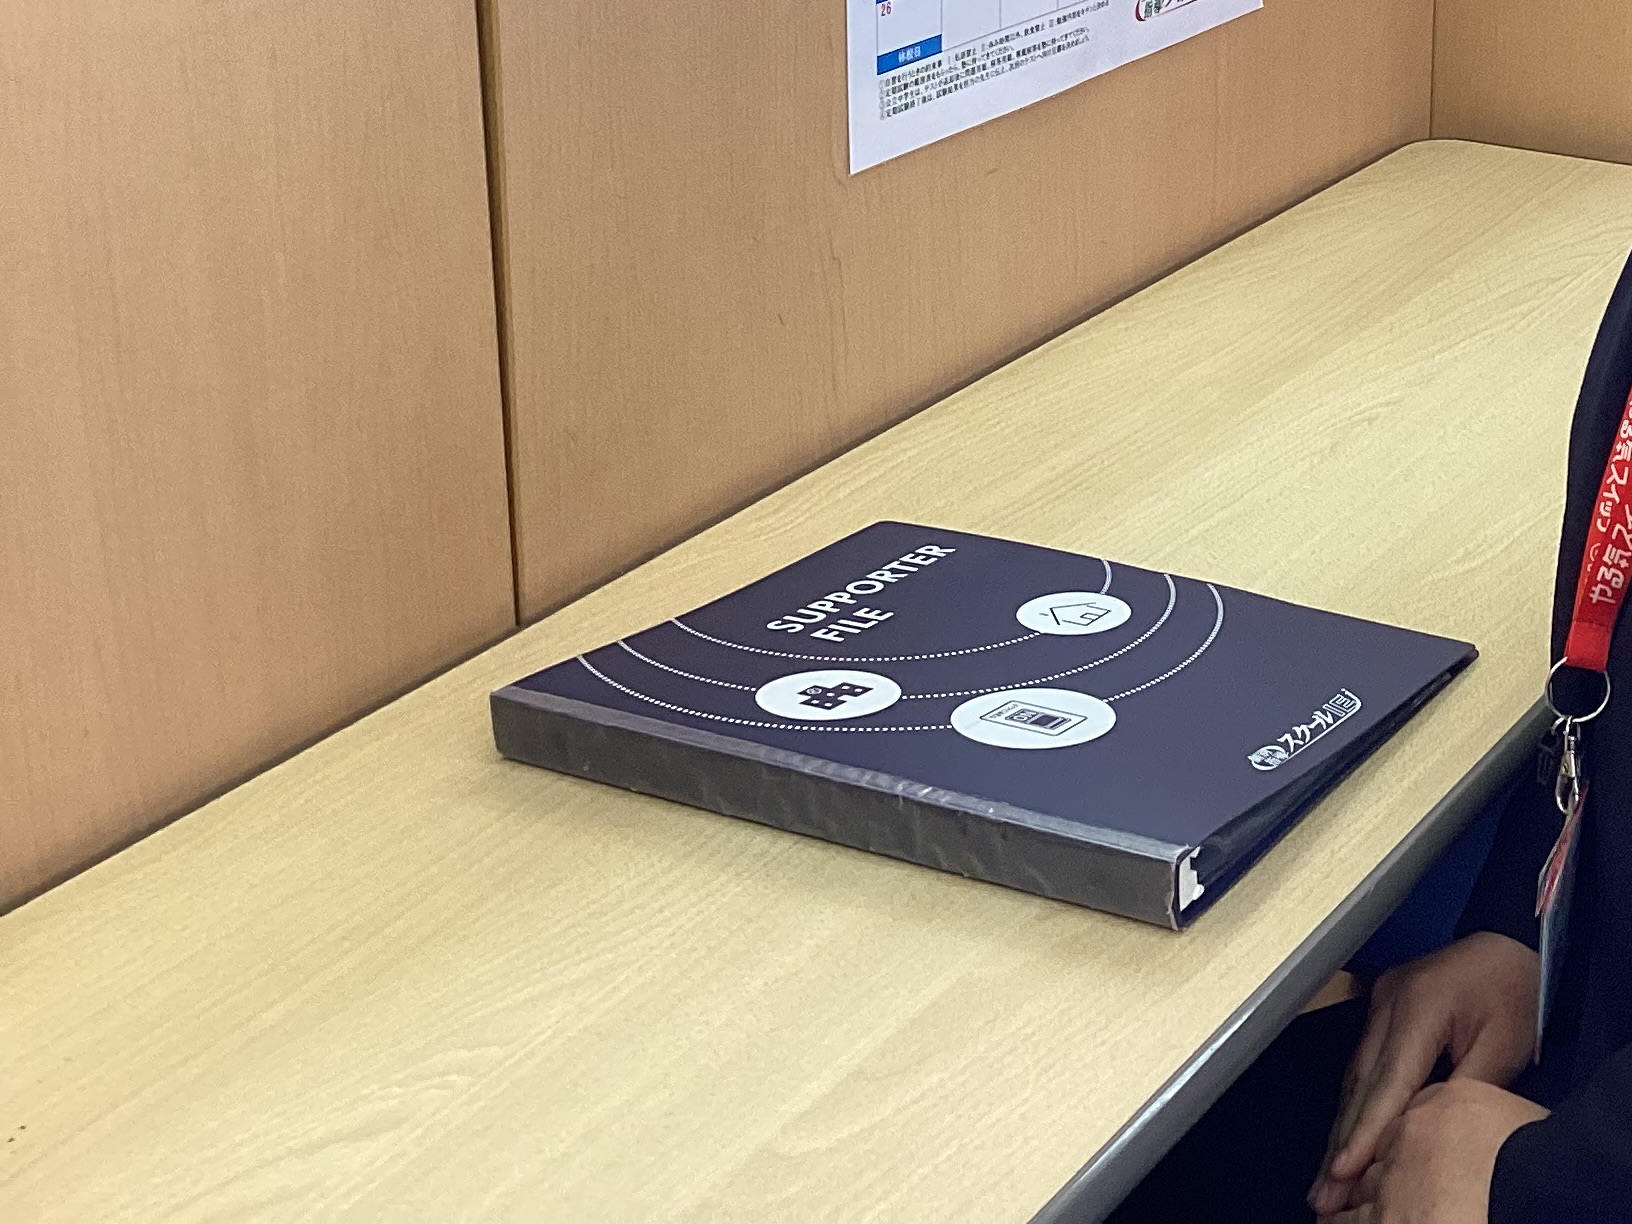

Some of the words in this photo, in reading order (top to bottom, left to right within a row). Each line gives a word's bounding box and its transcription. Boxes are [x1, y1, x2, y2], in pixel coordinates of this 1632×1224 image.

[880, 2, 892, 16] 26
[766, 544, 957, 634] SUPPORTER
[810, 607, 895, 643] FILE
[1276, 693, 1357, 753] スクールIE
